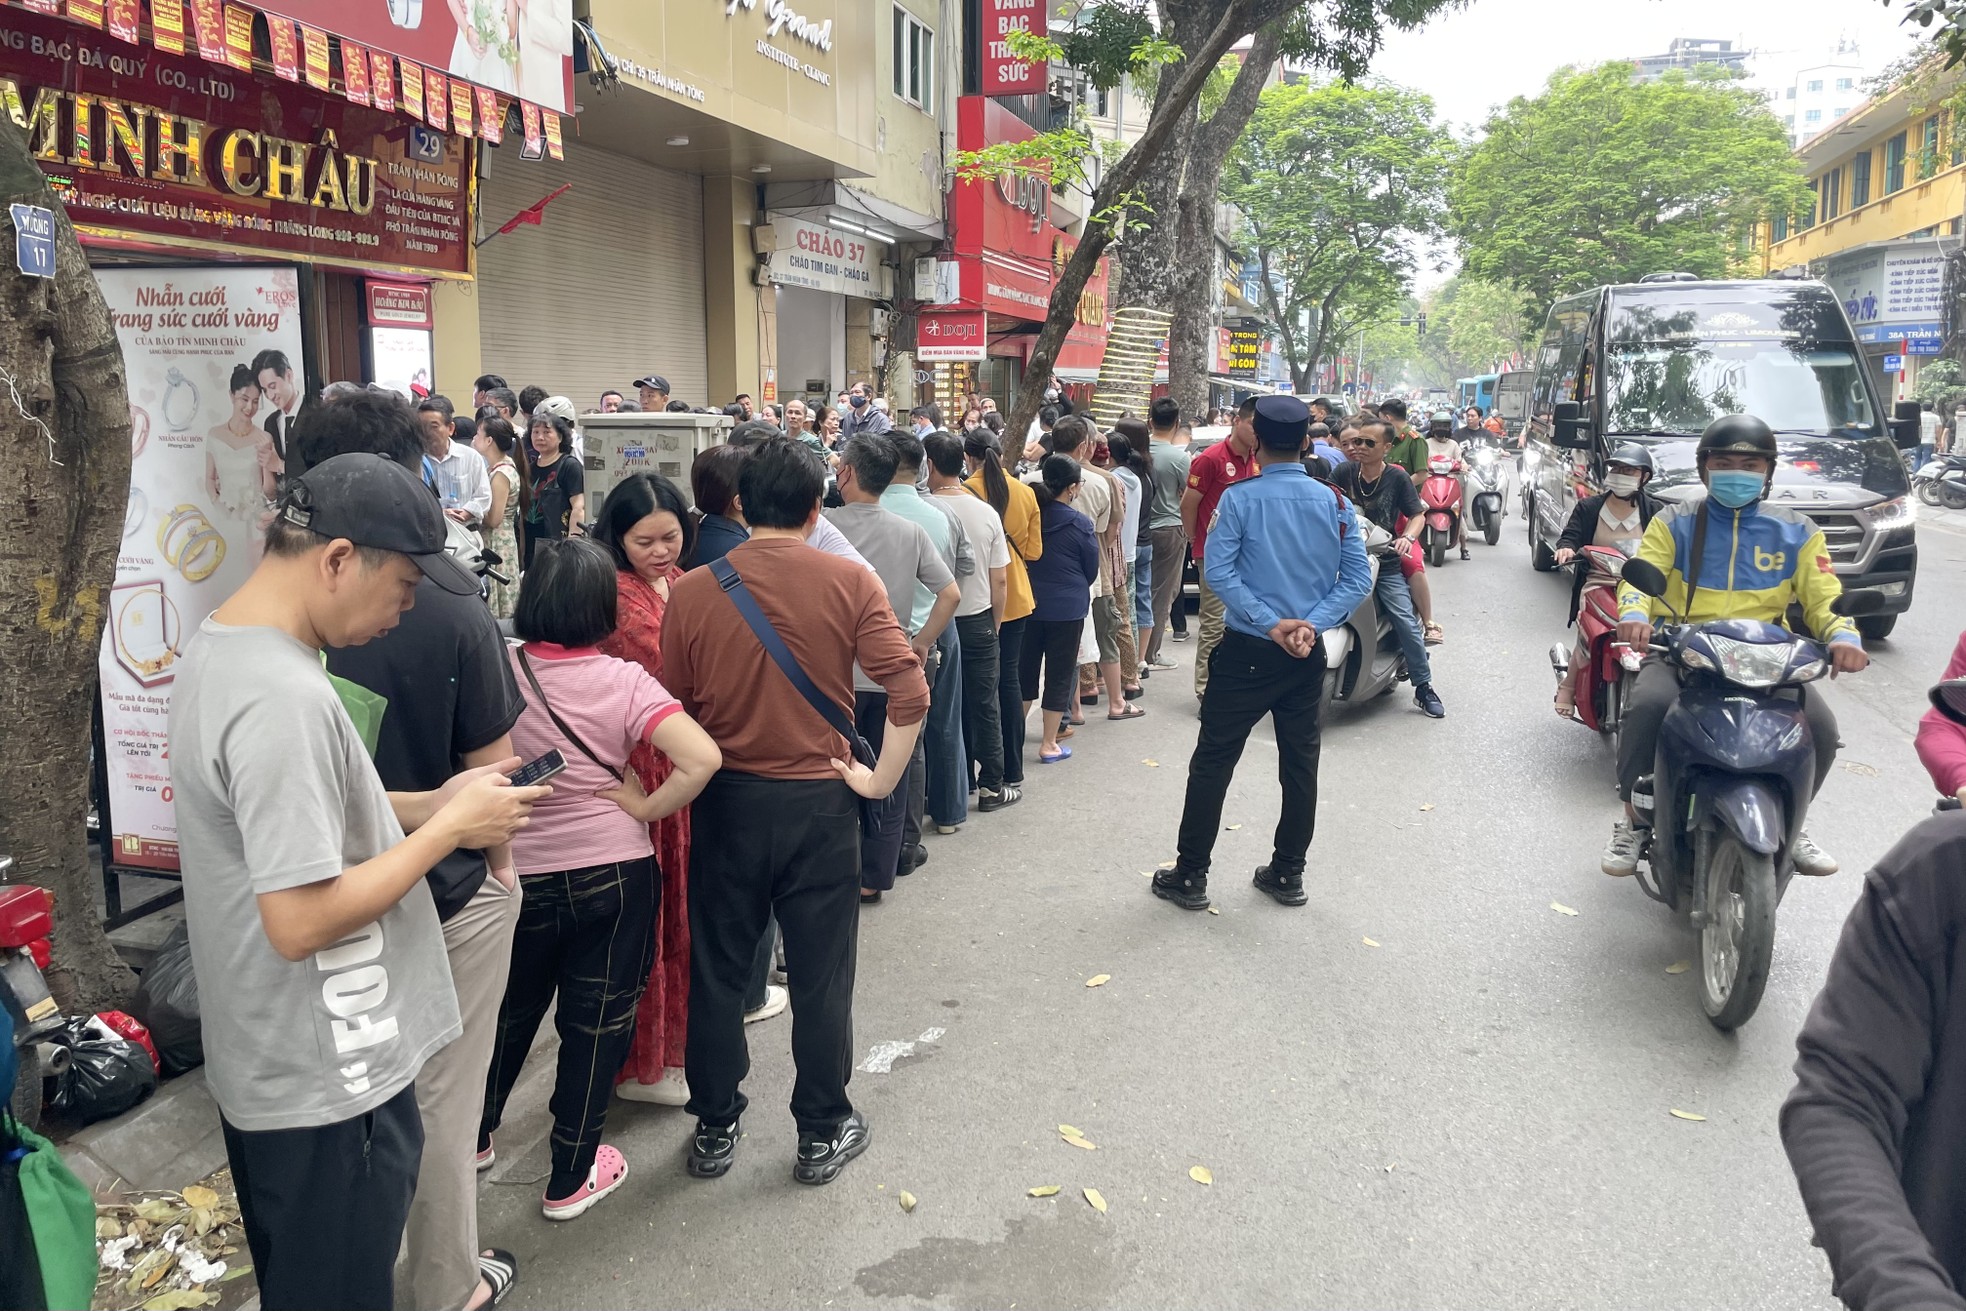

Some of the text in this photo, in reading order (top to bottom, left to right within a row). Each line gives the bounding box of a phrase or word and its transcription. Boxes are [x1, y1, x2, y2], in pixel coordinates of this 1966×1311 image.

[31, 35, 72, 64] BẠC
[78, 45, 104, 69] ĐÁ
[109, 56, 148, 79] QUÝ
[199, 79, 235, 102] LTD)
[756, 39, 800, 72] INSTITUTE
[804, 63, 831, 86] CLINIC
[998, 61, 1029, 83] SỨC
[636, 66, 646, 79] 35
[646, 68, 666, 88] TRẦN
[666, 73, 686, 94] NHÂN
[686, 80, 705, 102] TÔNG
[420, 133, 440, 157] 29
[220, 127, 378, 216] CHÂU
[33, 246, 46, 268] 17
[796, 229, 866, 264] CHÁO 37
[789, 255, 809, 270] CHÁO
[810, 260, 824, 273] TIM
[824, 264, 839, 276] GAN
[843, 267, 860, 280] CHÁO
[861, 270, 870, 282] GÀ
[136, 283, 227, 307] Nhẫn cưới
[265, 291, 296, 301] EROS
[157, 309, 187, 329] sức
[191, 308, 229, 328] cưới
[234, 307, 279, 332] vàng
[135, 335, 153, 346] CỦA
[194, 337, 218, 347] MINH
[220, 335, 246, 347] CHÂU
[943, 323, 977, 341] DOJI
[1888, 331, 1904, 339] 38A
[1753, 545, 1786, 572] be
